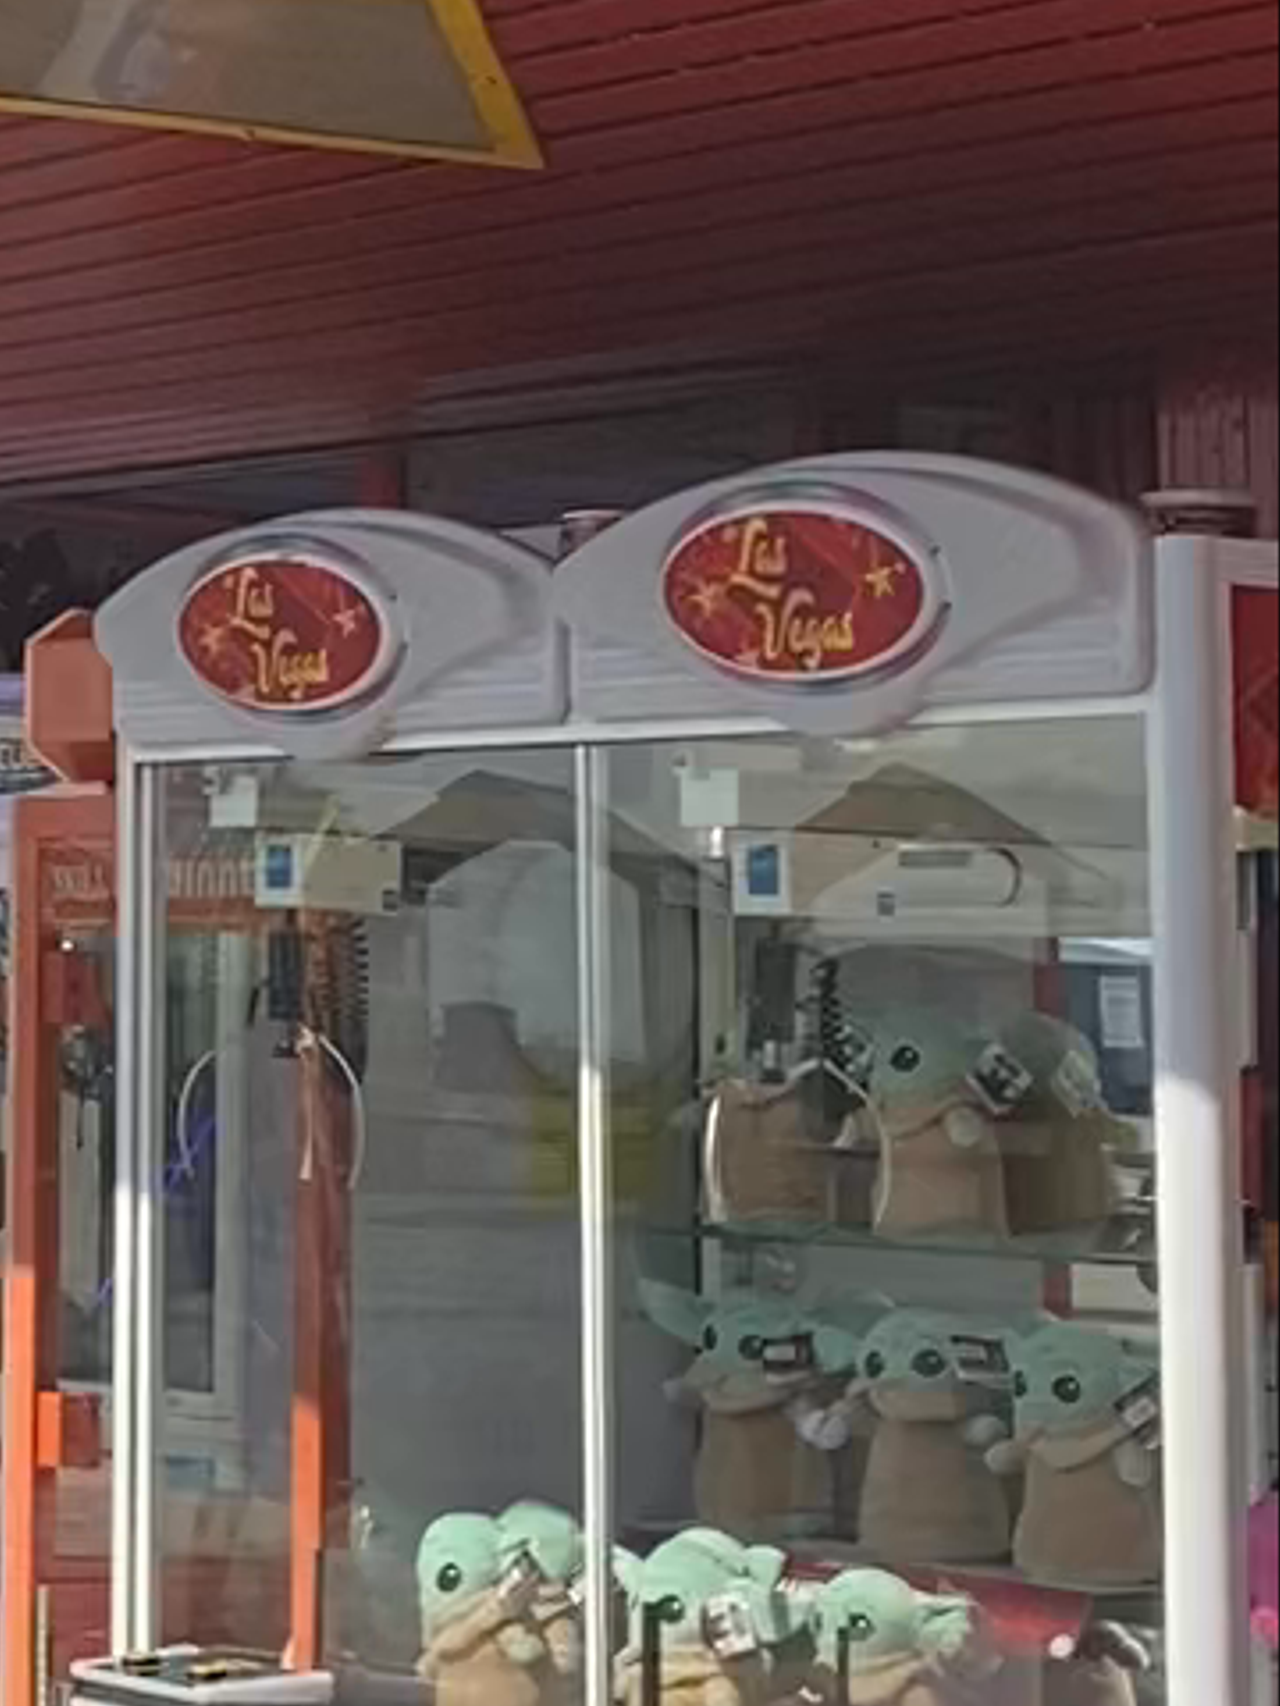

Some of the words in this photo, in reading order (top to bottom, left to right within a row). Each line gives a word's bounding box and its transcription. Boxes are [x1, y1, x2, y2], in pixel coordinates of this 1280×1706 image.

[730, 517, 787, 599] Las
[250, 628, 329, 700] Vegas
[754, 587, 854, 670] Vegas
